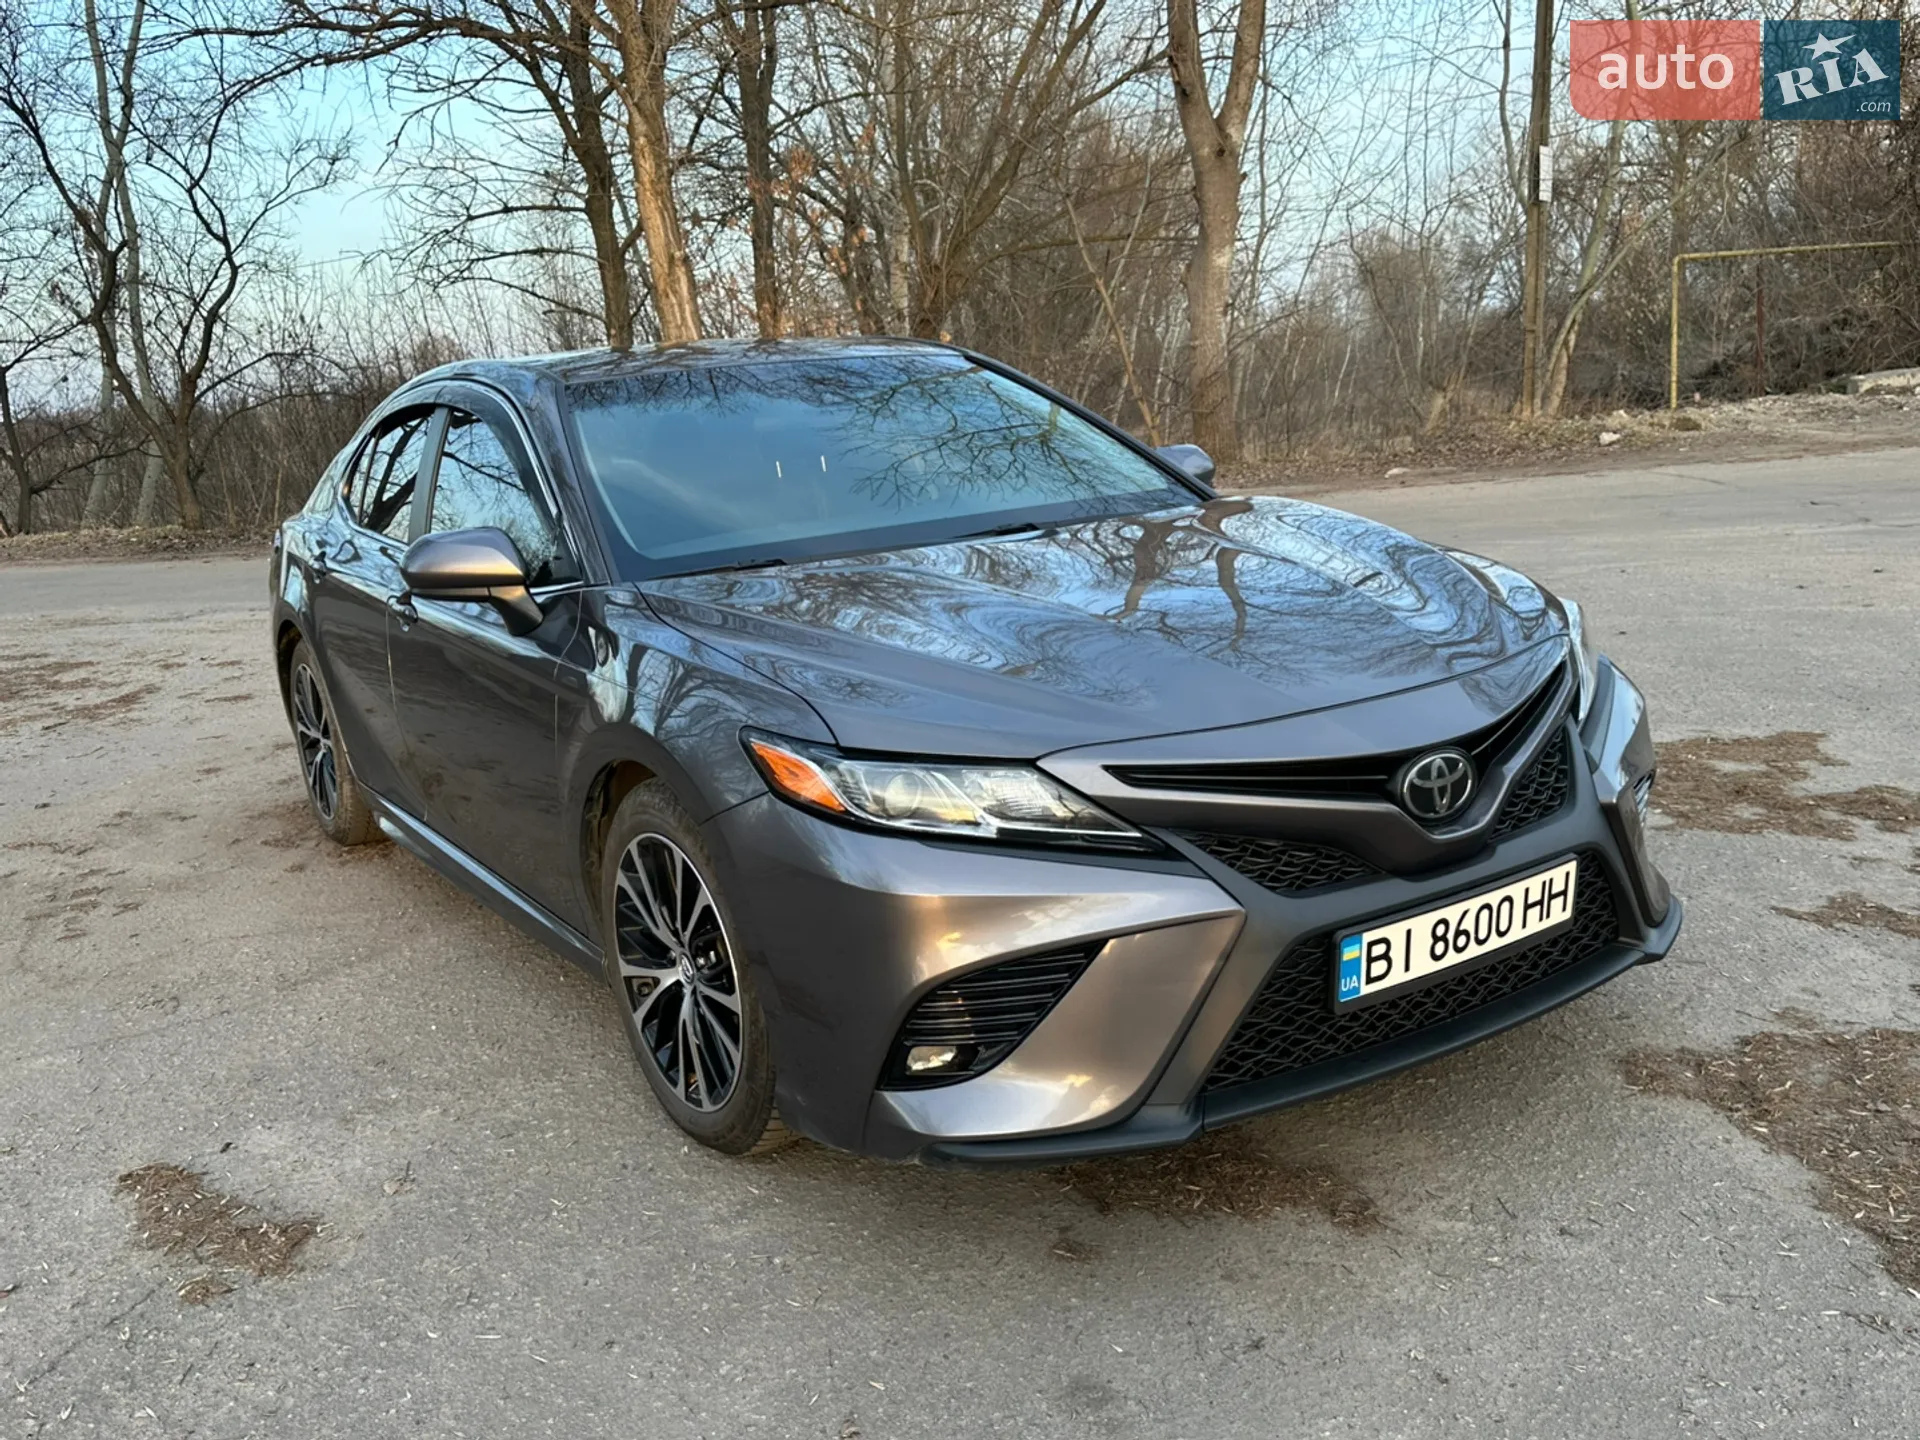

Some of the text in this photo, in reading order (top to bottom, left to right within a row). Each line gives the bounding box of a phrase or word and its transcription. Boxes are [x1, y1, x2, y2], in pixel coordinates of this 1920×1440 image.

[1365, 871, 1570, 986] BI 8600 HH
[1341, 975, 1359, 992] UA
